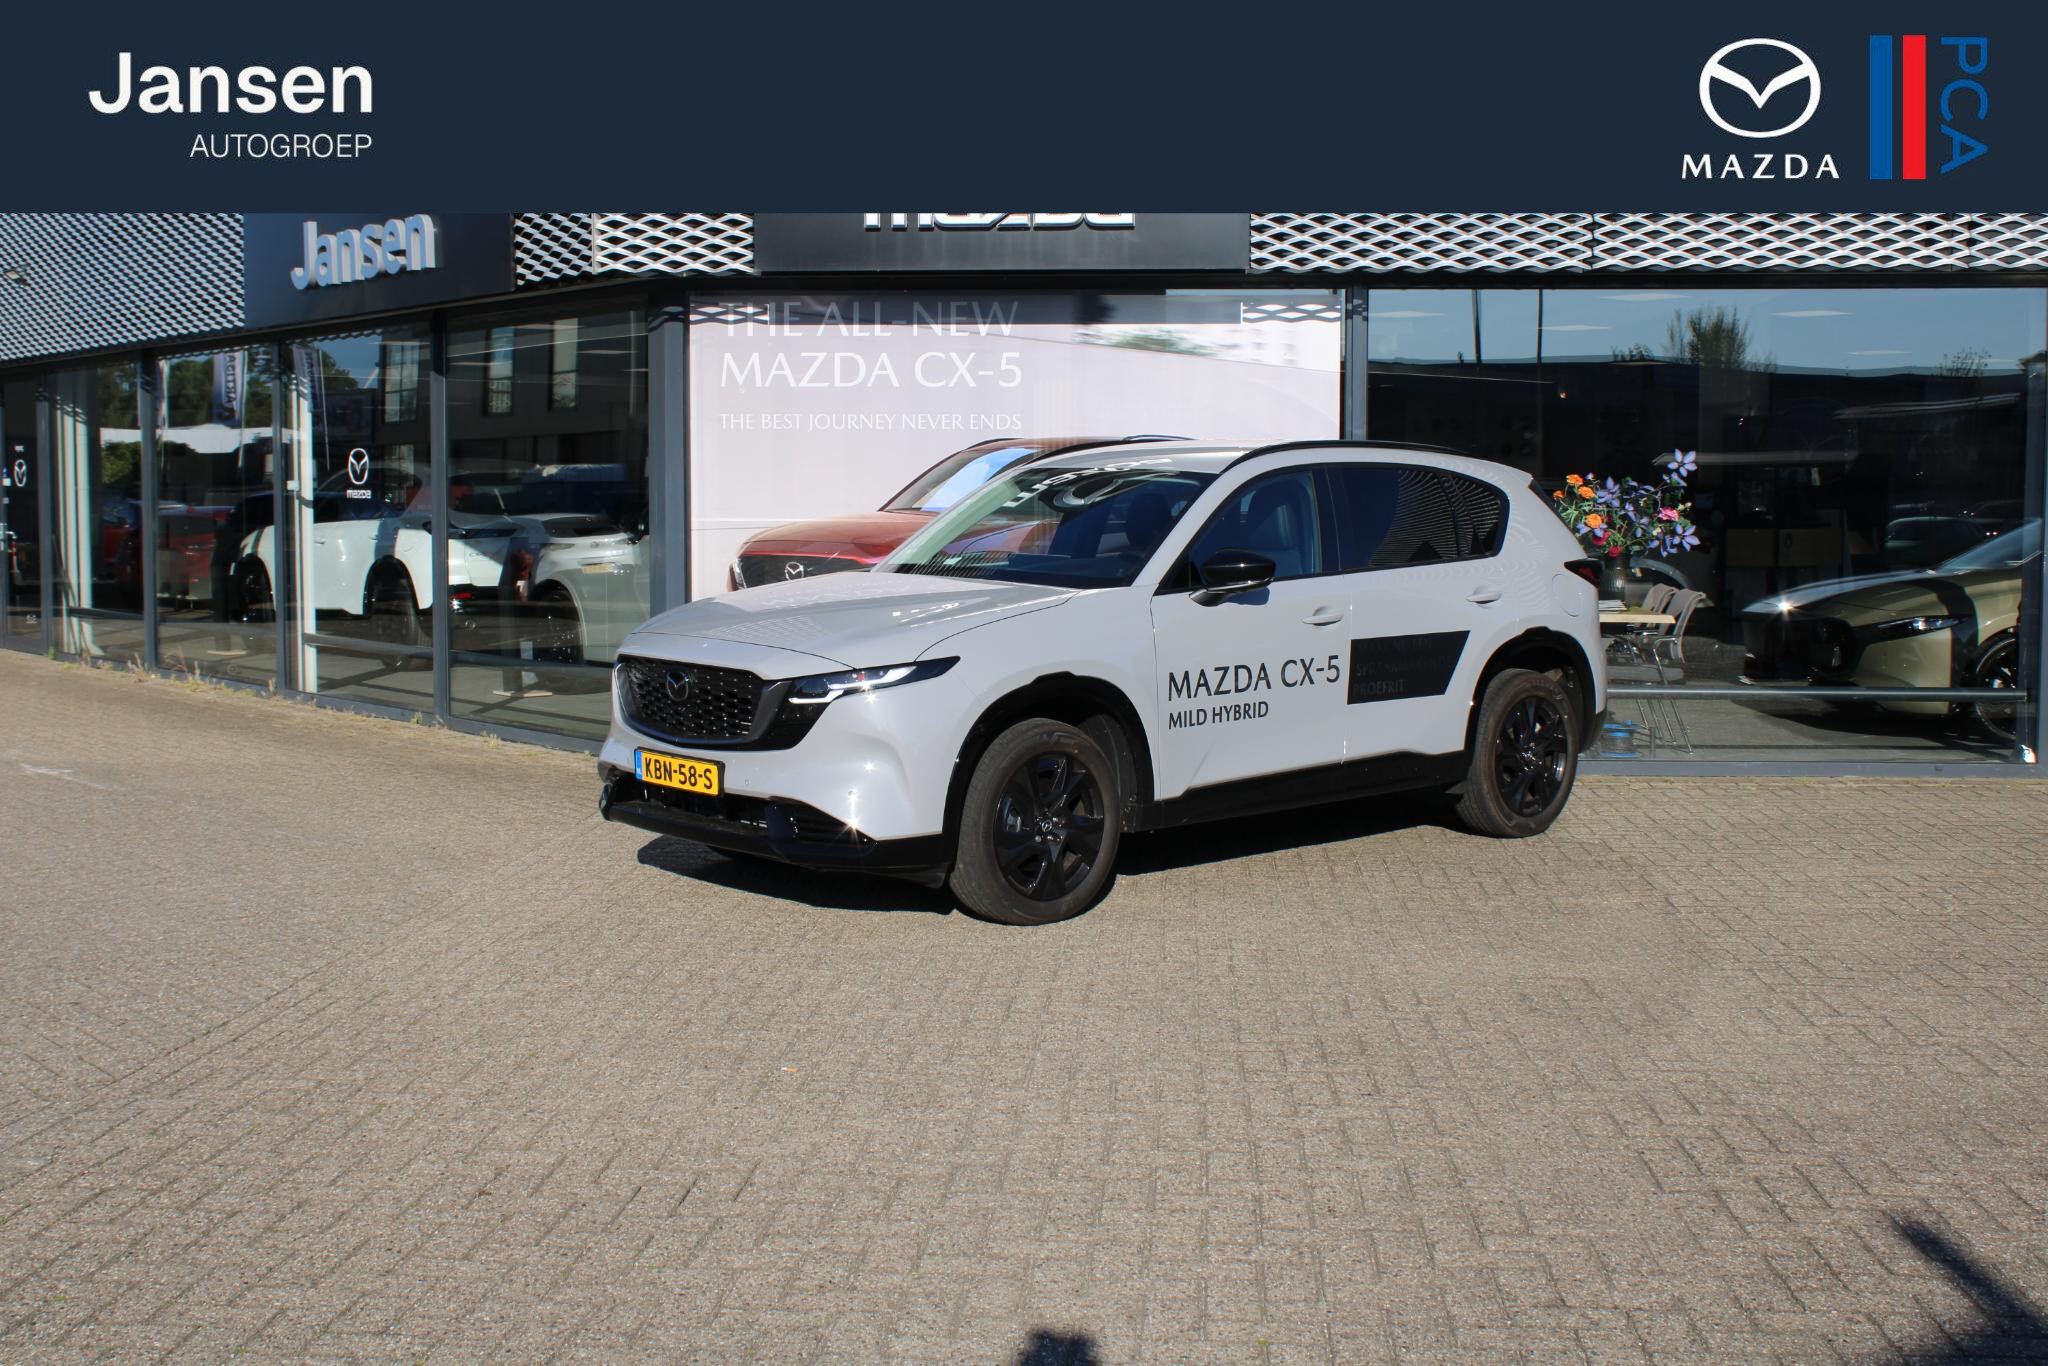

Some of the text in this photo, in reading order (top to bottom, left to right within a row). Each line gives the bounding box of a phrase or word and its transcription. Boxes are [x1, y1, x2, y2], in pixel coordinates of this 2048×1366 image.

[290, 213, 436, 290] Jansen
[719, 301, 1018, 337] THE ALL-NEW
[720, 351, 1022, 388] MAZDA CX-5
[719, 413, 1022, 431] THE BEST JOURNEY NEVER ENDS
[1168, 662, 1272, 702] MAZDA
[1280, 654, 1341, 688] CX-5
[1168, 700, 1269, 730] MILD HYBRID
[644, 757, 713, 790] KBN-58-S
